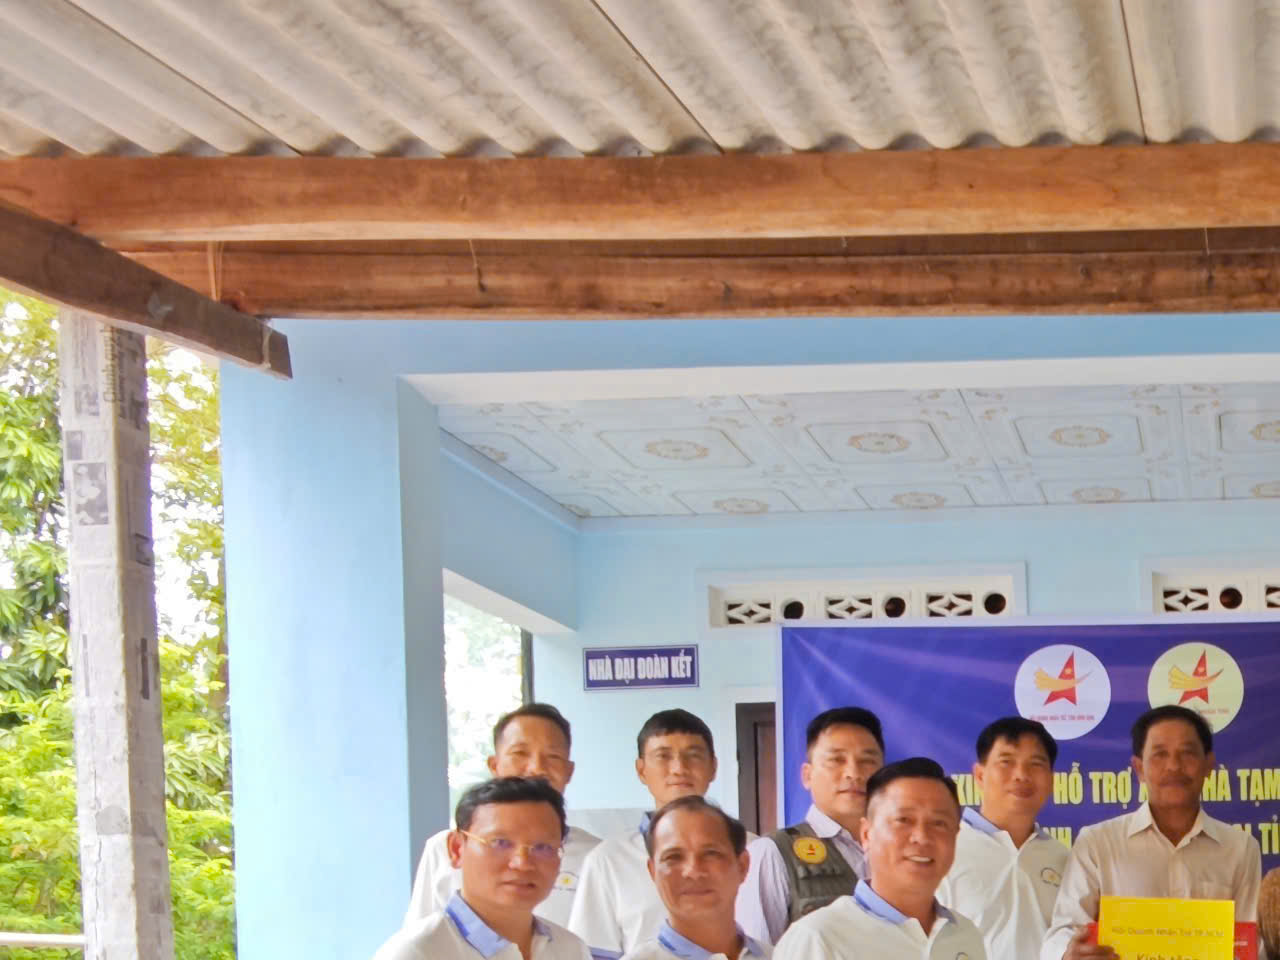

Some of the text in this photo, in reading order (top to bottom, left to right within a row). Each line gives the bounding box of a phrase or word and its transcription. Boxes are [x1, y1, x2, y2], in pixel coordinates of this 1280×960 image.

[588, 649, 692, 684] NHÀ ĐẠI ĐOÀN KẾT
[1054, 761, 1083, 805] HỖ
[1089, 766, 1132, 810] TRỢ
[1202, 763, 1232, 802] HÀ
